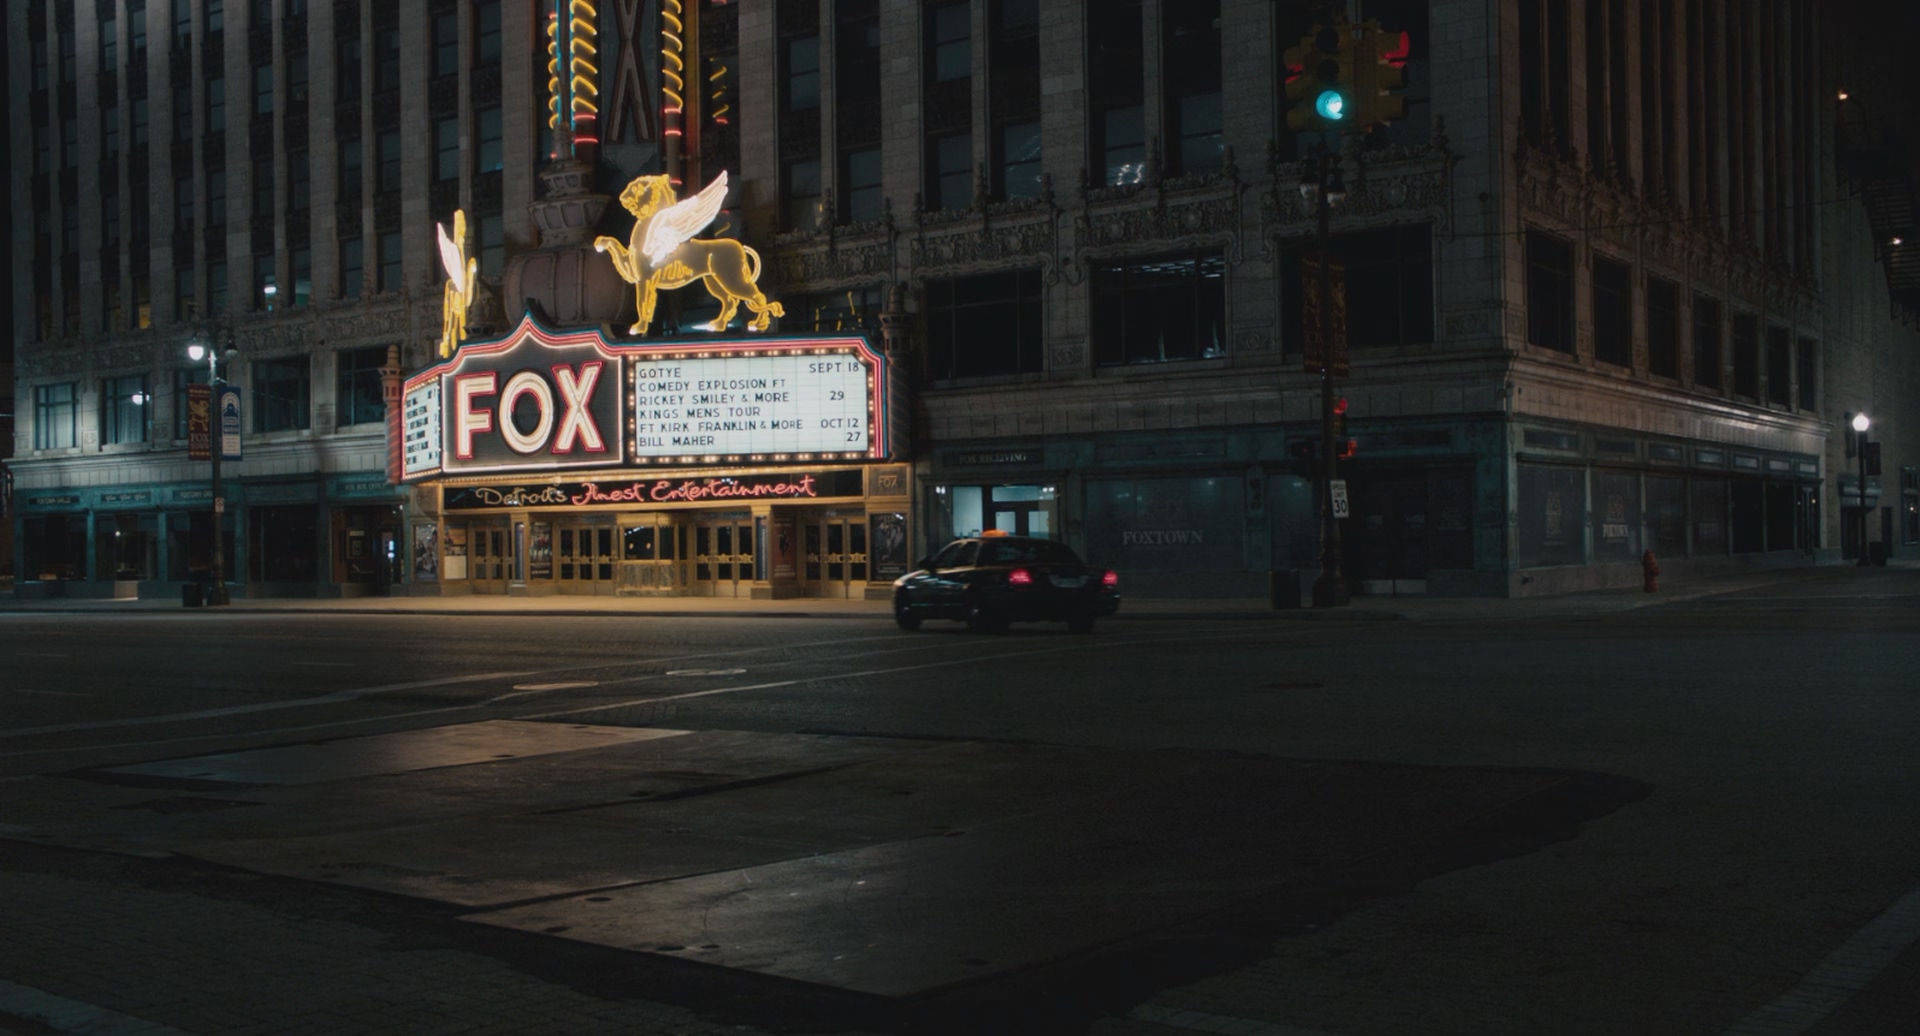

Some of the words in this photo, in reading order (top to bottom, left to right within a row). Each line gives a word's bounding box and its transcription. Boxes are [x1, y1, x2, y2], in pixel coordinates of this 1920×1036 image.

[639, 367, 682, 379] GOTYE
[808, 362, 842, 373] SEPT
[847, 362, 860, 372] 18
[639, 381, 690, 392] COMEDY
[698, 379, 767, 391] EXPLOSION
[772, 378, 786, 388] FT
[639, 395, 684, 406] RICKEY
[692, 393, 735, 405] SMILEY
[741, 394, 748, 403] &
[754, 392, 790, 403] MORE
[829, 391, 845, 401] 29
[454, 360, 607, 460] FOX
[639, 408, 679, 420] KINGS
[686, 407, 720, 418] MENS
[728, 406, 761, 417] TOUR
[639, 423, 655, 433] FT
[660, 421, 690, 433] KIRK
[698, 419, 757, 431] FRANKLIN
[760, 420, 767, 429] &
[771, 419, 803, 430] MORE
[820, 418, 843, 429] OCT
[847, 417, 860, 428] 12
[190, 433, 209, 442] FOX
[639, 436, 665, 447] BILL
[672, 434, 715, 446] MAHER
[846, 431, 861, 442] 27
[475, 486, 568, 506] Detroit's
[572, 482, 646, 506] Finest
[649, 475, 817, 501] Entertainment
[1334, 499, 1347, 513] 30
[1122, 529, 1203, 545] FOXTOWN
